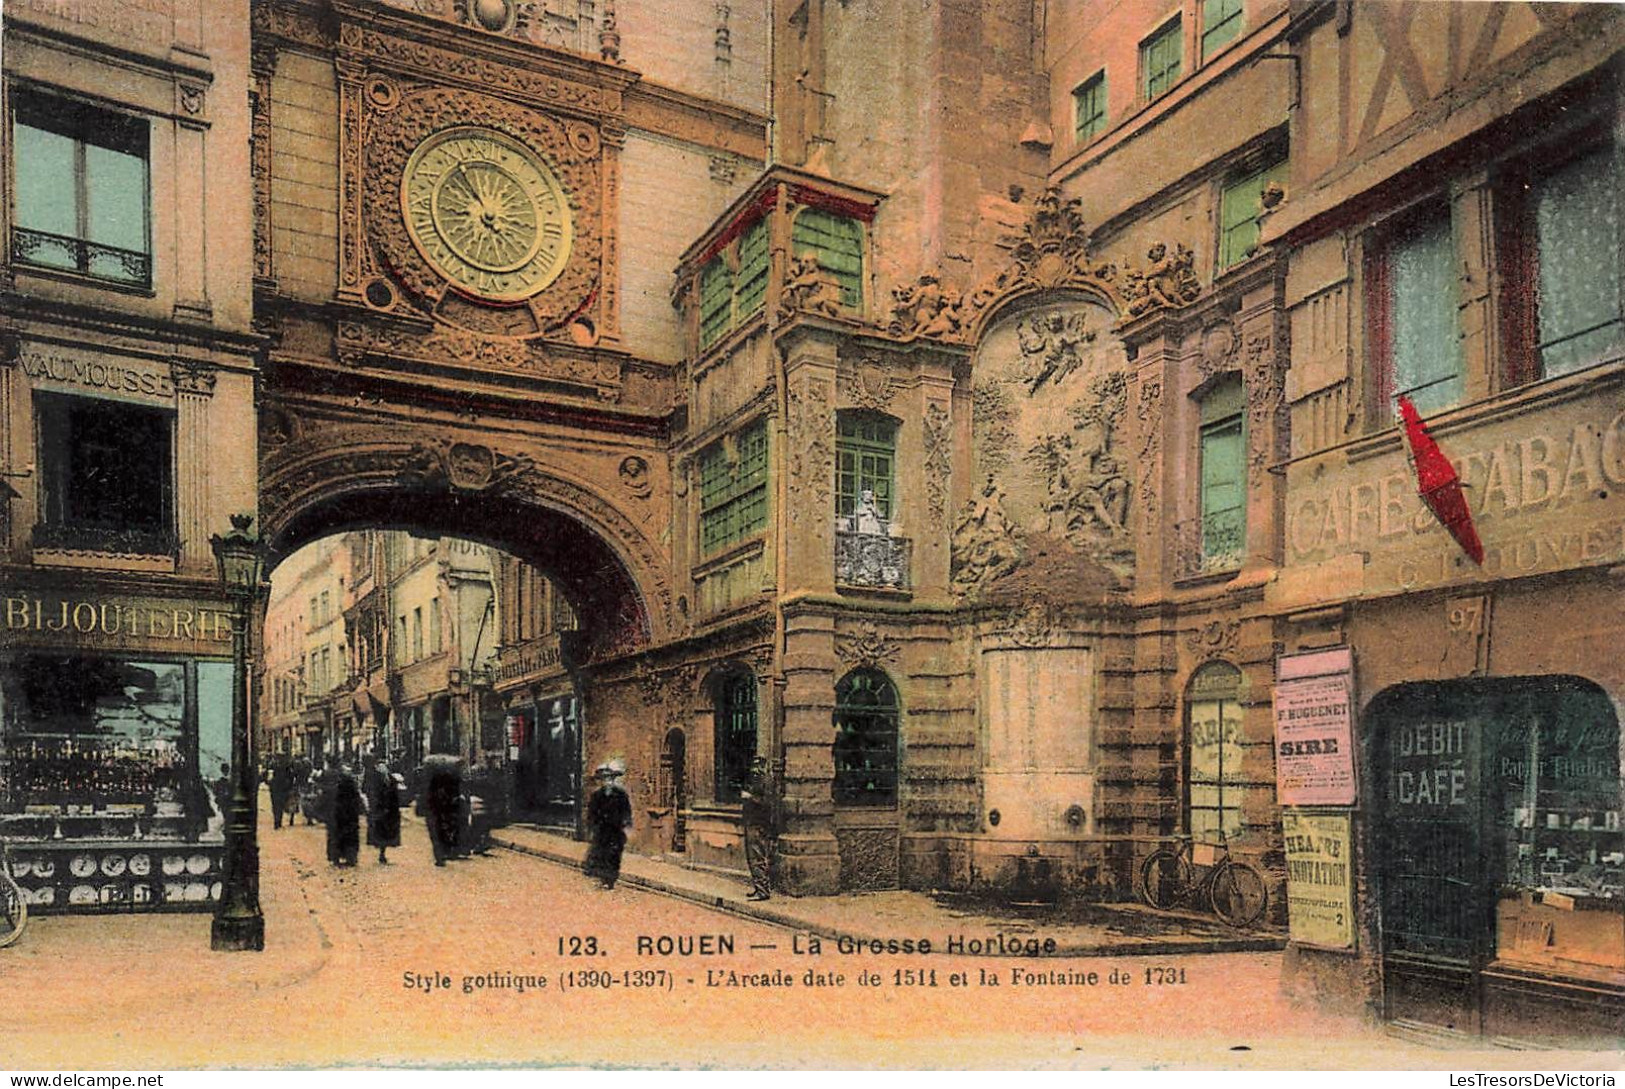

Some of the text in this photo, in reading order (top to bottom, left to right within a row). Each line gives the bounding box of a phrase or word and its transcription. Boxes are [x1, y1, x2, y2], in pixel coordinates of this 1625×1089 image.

[18, 350, 175, 398] VAUMOUSSE
[6, 597, 234, 642] BIJOUTERIE
[1450, 608, 1481, 632] 97
[1280, 738, 1339, 757] SIRE
[1398, 759, 1466, 805] CAFÉ
[1336, 913, 1344, 926] 2
